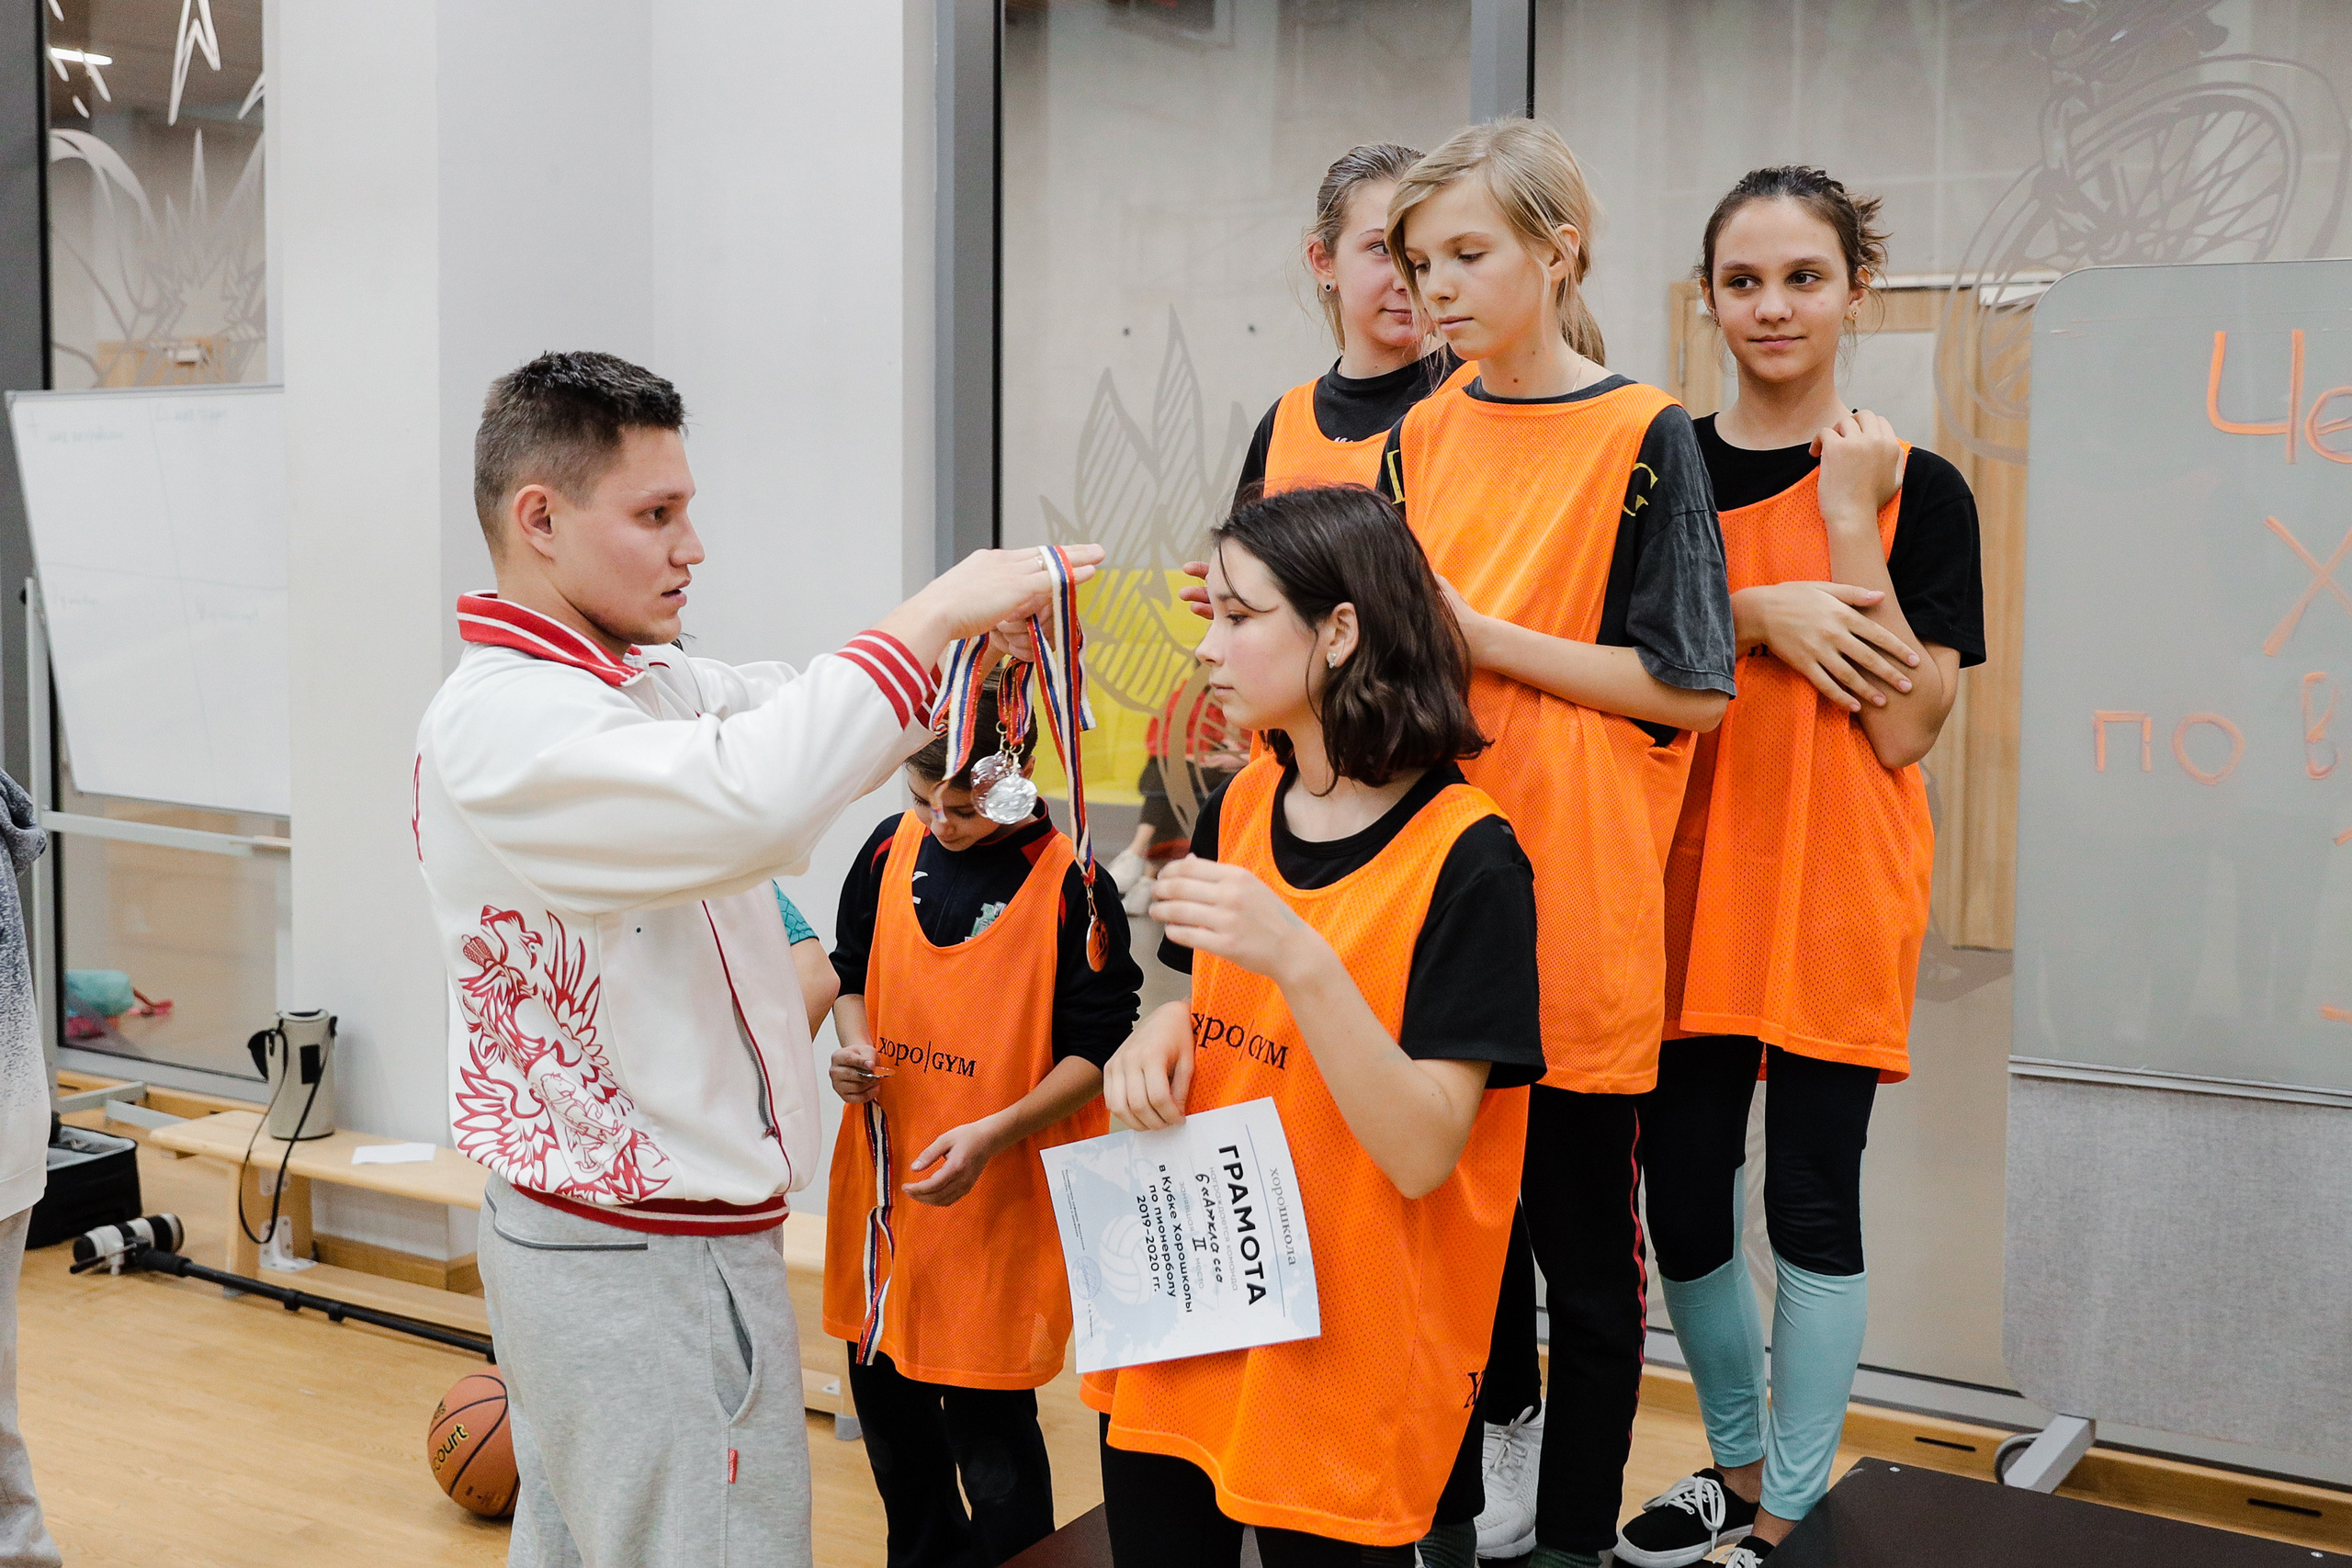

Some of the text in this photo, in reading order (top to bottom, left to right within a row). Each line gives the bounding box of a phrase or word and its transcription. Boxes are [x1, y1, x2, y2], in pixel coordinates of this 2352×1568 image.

[1136, 1195, 1159, 1271] 2019-2020
[1148, 1185, 1176, 1297] по пионерболу
[1159, 1164, 1192, 1313] в Кубке Хорошколы
[1179, 1181, 1195, 1232] занявшая
[1195, 1258, 1204, 1289] место
[1209, 1166, 1238, 1292] награждается команда
[1218, 1145, 1266, 1305] ГРАМОТА
